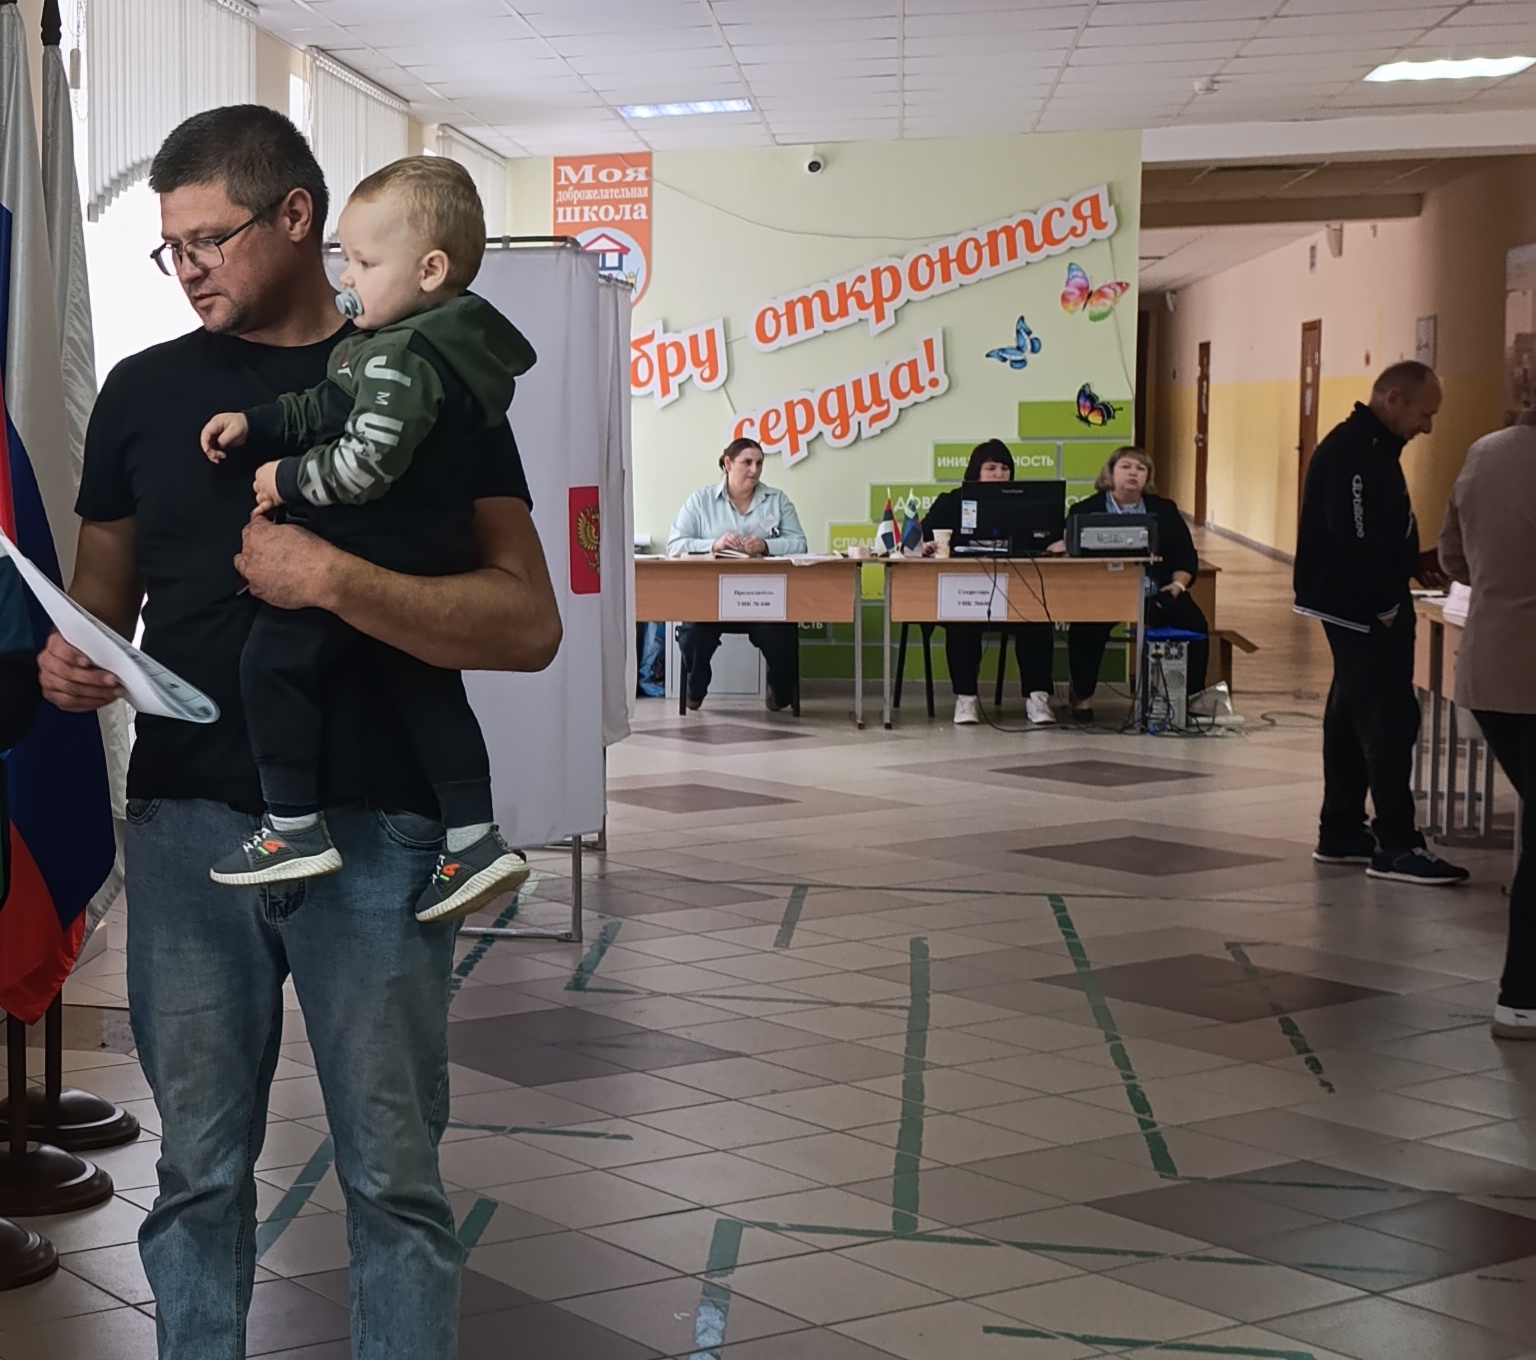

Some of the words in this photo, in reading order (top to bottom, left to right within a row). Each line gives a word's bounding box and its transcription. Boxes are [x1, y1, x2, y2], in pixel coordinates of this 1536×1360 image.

[556, 164, 648, 185] Моя
[556, 186, 648, 204] доброжелательная
[556, 203, 648, 223] школа
[630, 327, 720, 399] бру
[754, 193, 1109, 345] откроются
[733, 337, 940, 457] сердца!
